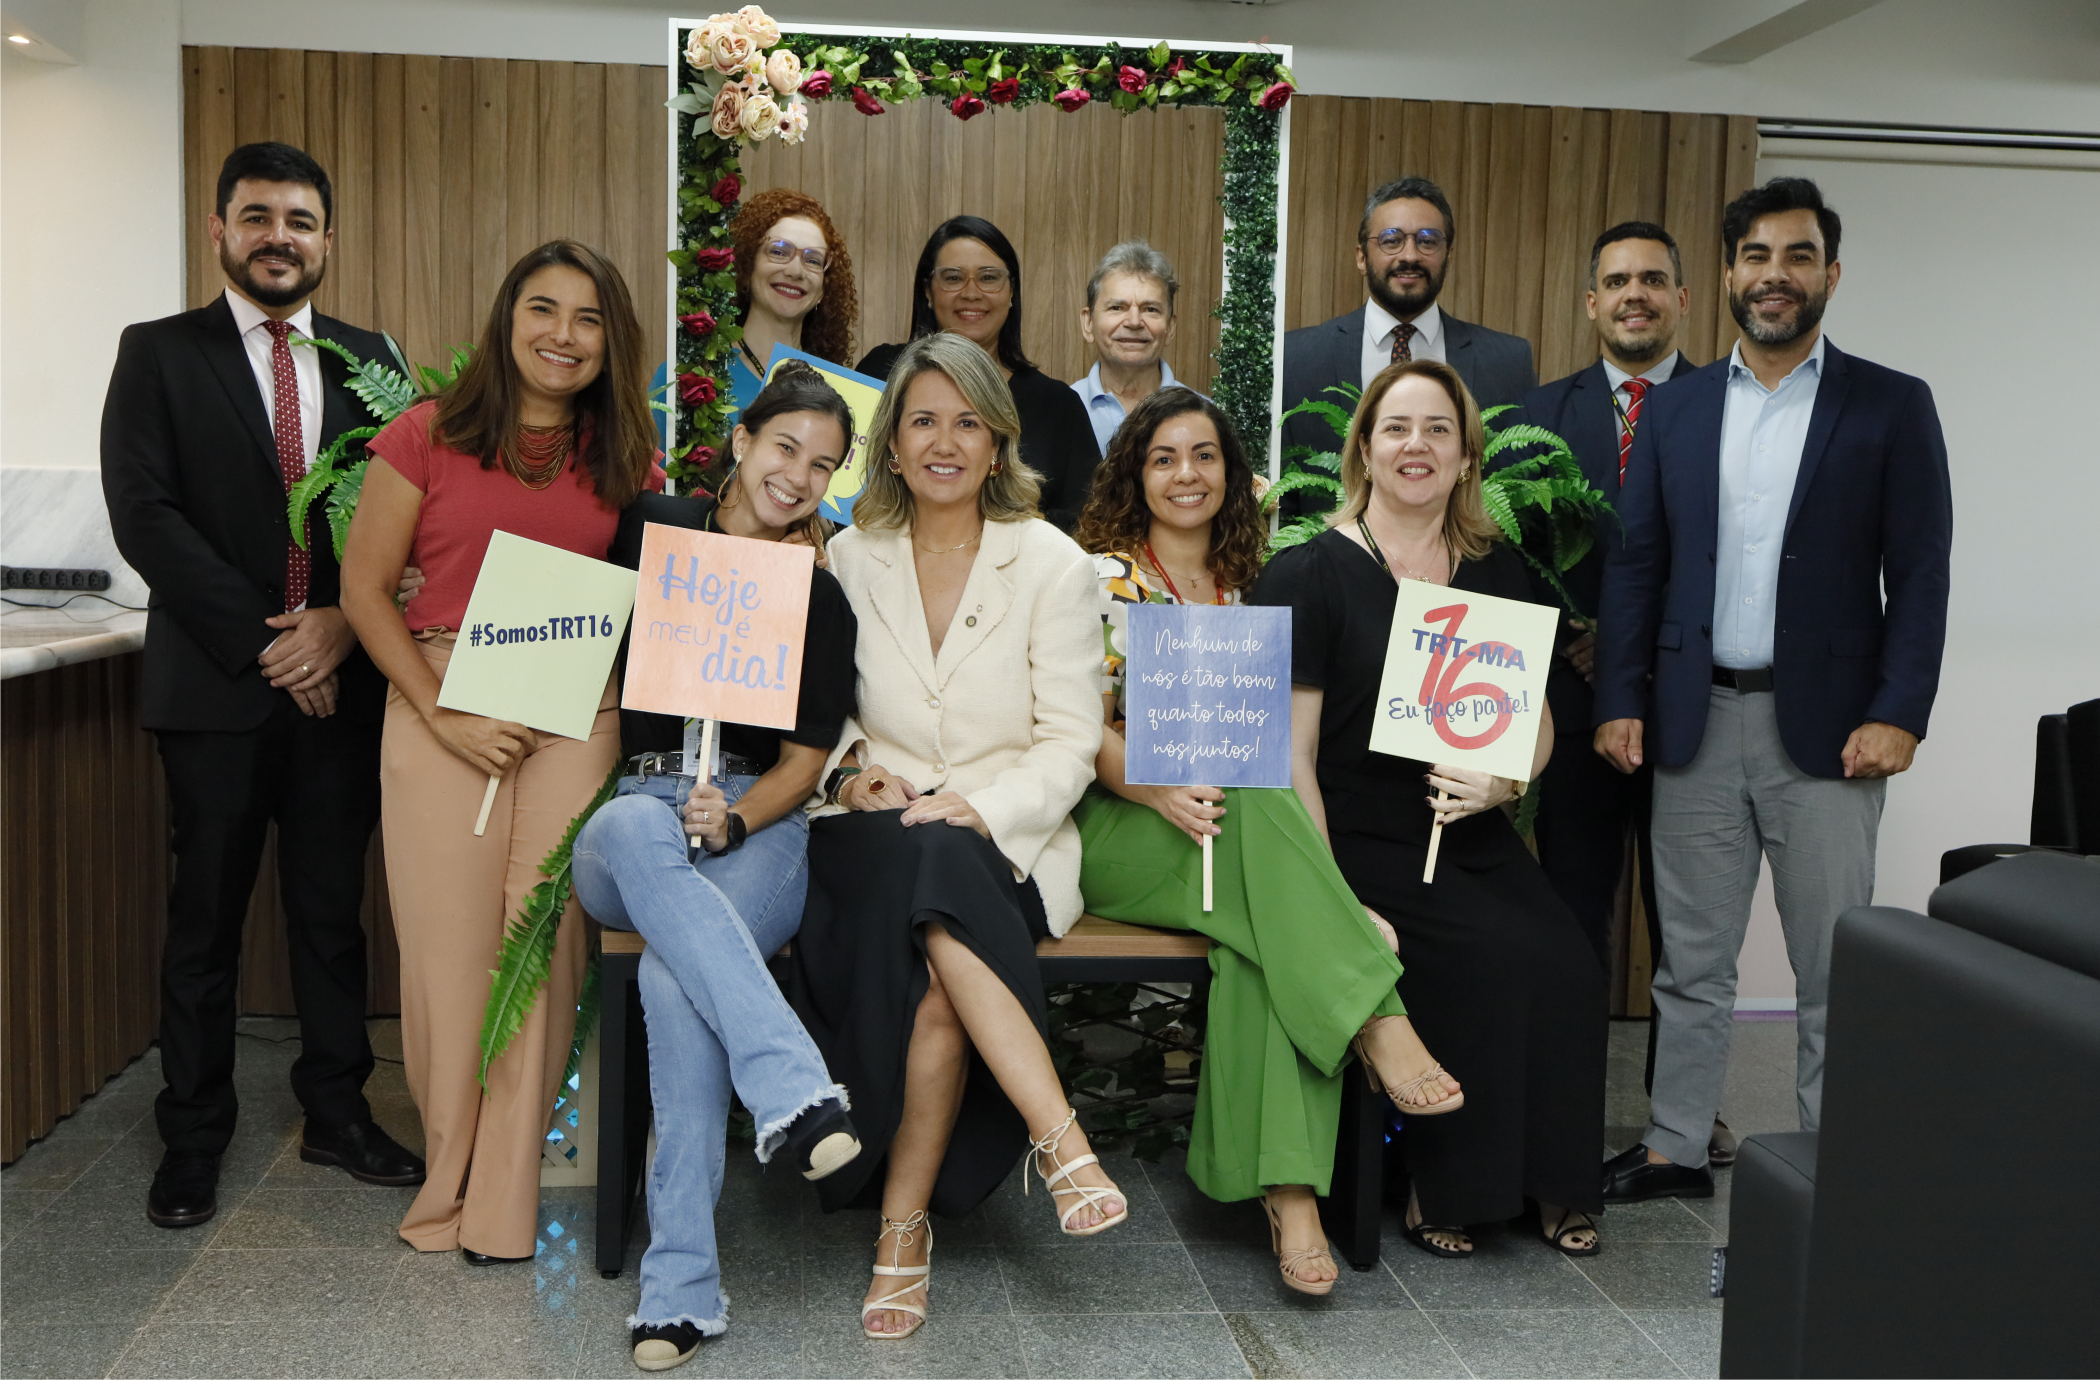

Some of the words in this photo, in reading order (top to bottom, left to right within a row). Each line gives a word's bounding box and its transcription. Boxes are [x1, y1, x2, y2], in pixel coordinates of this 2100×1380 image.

[658, 553, 761, 626] Hoje
[470, 614, 613, 647] #SomosTRT16
[649, 621, 711, 646] MEU
[736, 615, 750, 638] é
[1155, 625, 1238, 656] Nenhum
[1242, 628, 1262, 657] de
[701, 633, 789, 691] dia!
[1412, 628, 1526, 672] TRT-MA
[1142, 669, 1178, 690] nós
[1181, 669, 1193, 685] é
[1193, 665, 1229, 688] tão
[1233, 663, 1276, 690] bom
[1418, 603, 1513, 750] 16
[1148, 700, 1214, 731] quanto
[1215, 698, 1269, 727] todos
[1388, 697, 1419, 720] Eu
[1424, 695, 1467, 725] faço
[1473, 690, 1530, 722] parte!
[1153, 739, 1189, 761] nós
[1189, 735, 1260, 764] juntos!
